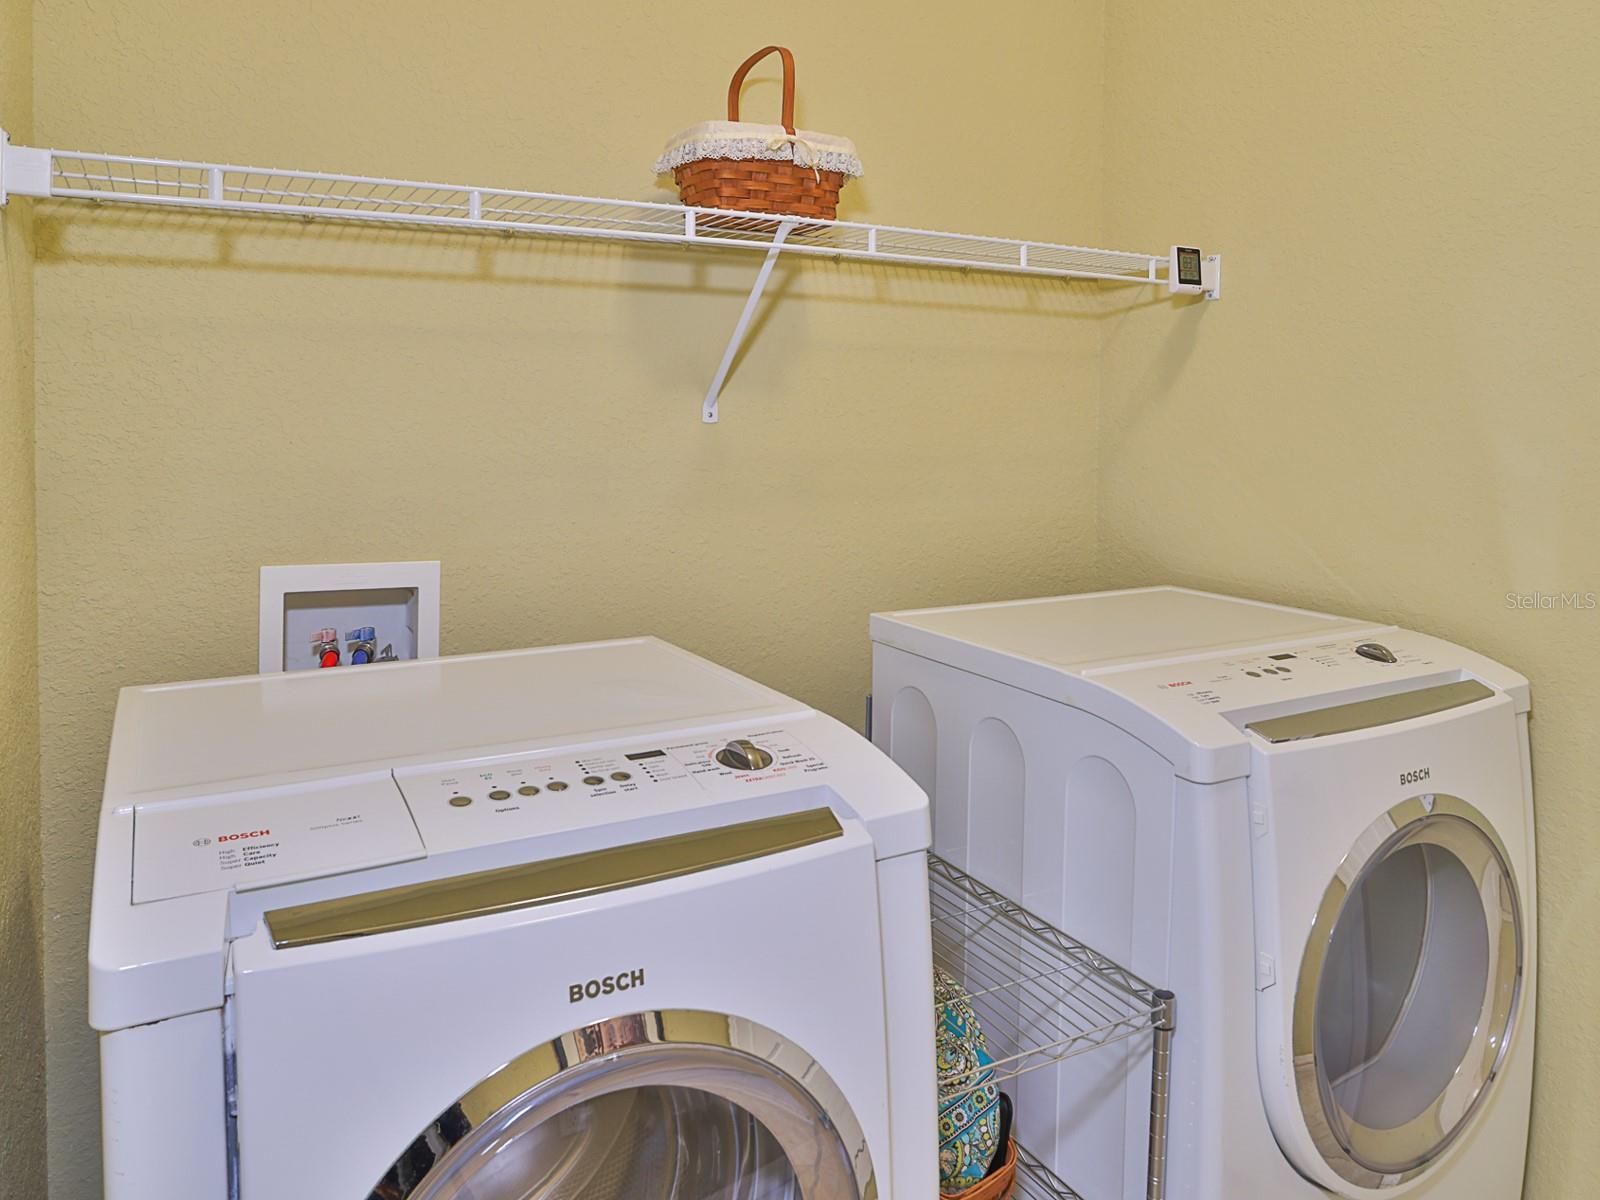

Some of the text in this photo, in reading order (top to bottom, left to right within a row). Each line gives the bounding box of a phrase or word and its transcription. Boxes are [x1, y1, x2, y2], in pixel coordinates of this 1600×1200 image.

[1400, 767, 1430, 785] BOSCH
[218, 829, 271, 843] BOSCH
[242, 842, 280, 852] Efficiency
[243, 853, 277, 862] Capacity
[569, 968, 645, 1003] BOSCH
